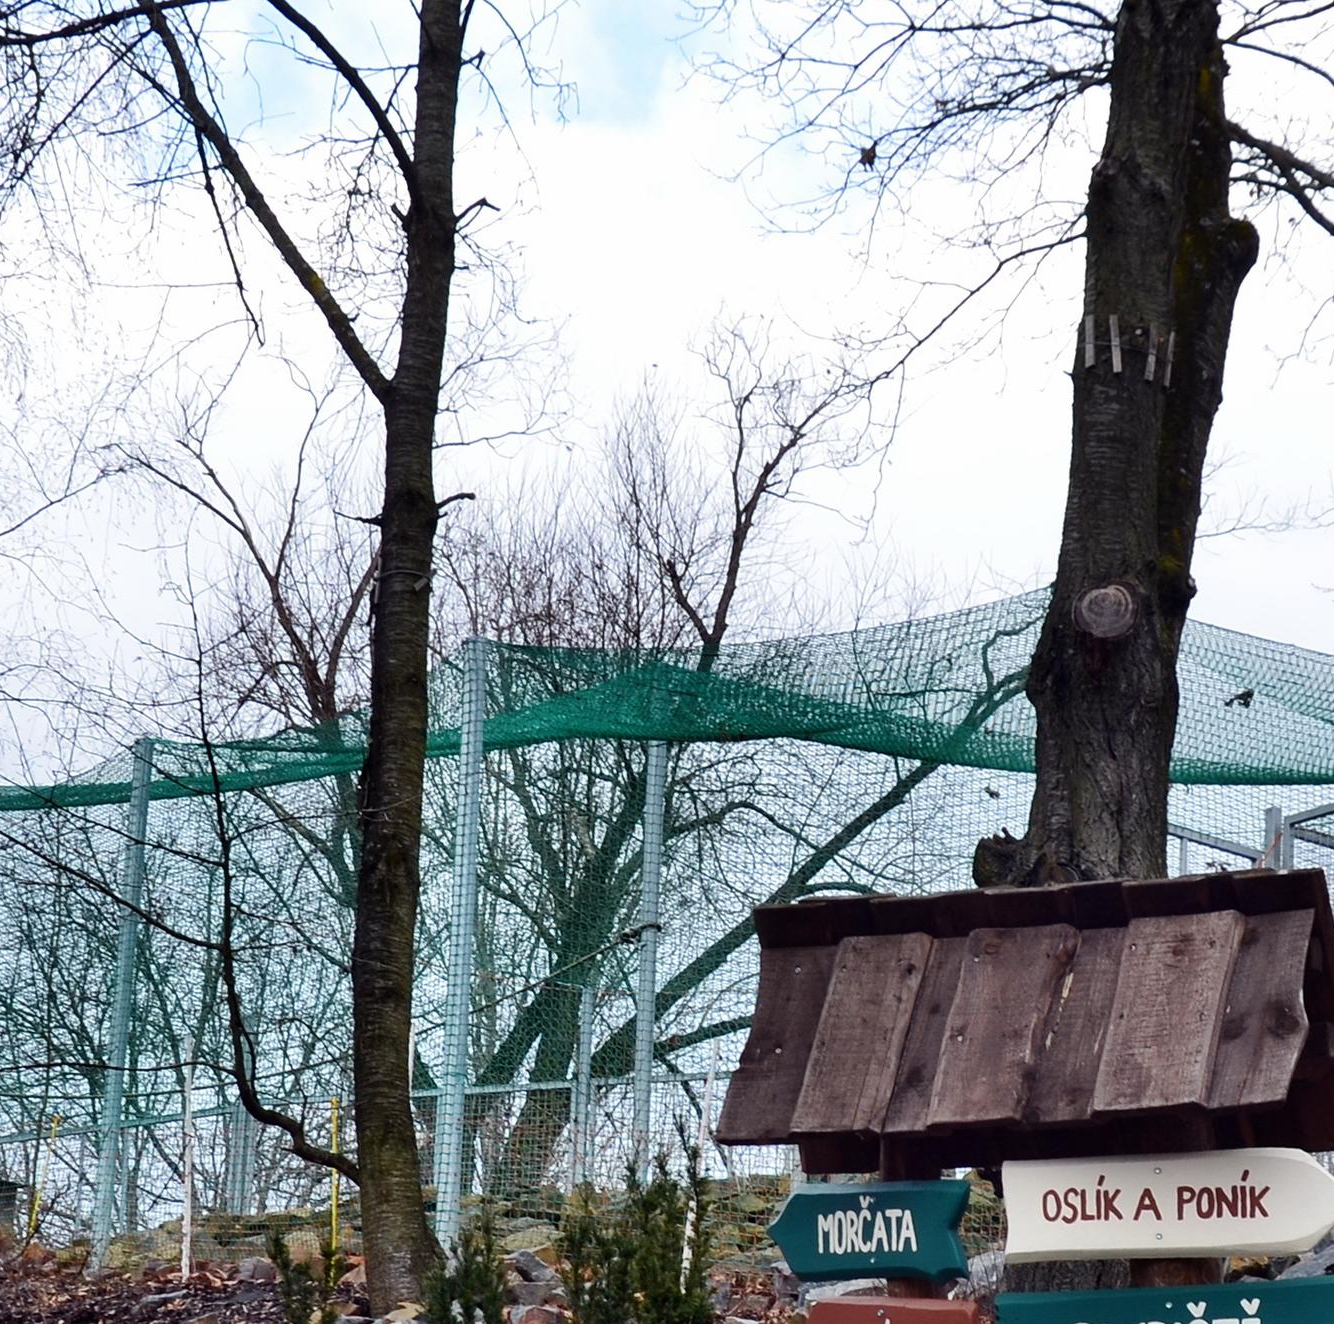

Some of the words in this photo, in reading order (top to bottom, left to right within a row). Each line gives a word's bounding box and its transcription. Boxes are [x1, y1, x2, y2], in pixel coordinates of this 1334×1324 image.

[1041, 1174, 1123, 1223] OSLÍK
[1134, 1187, 1163, 1222] A
[1177, 1169, 1271, 1221] PONÍK
[817, 1195, 917, 1255] MORČATA
